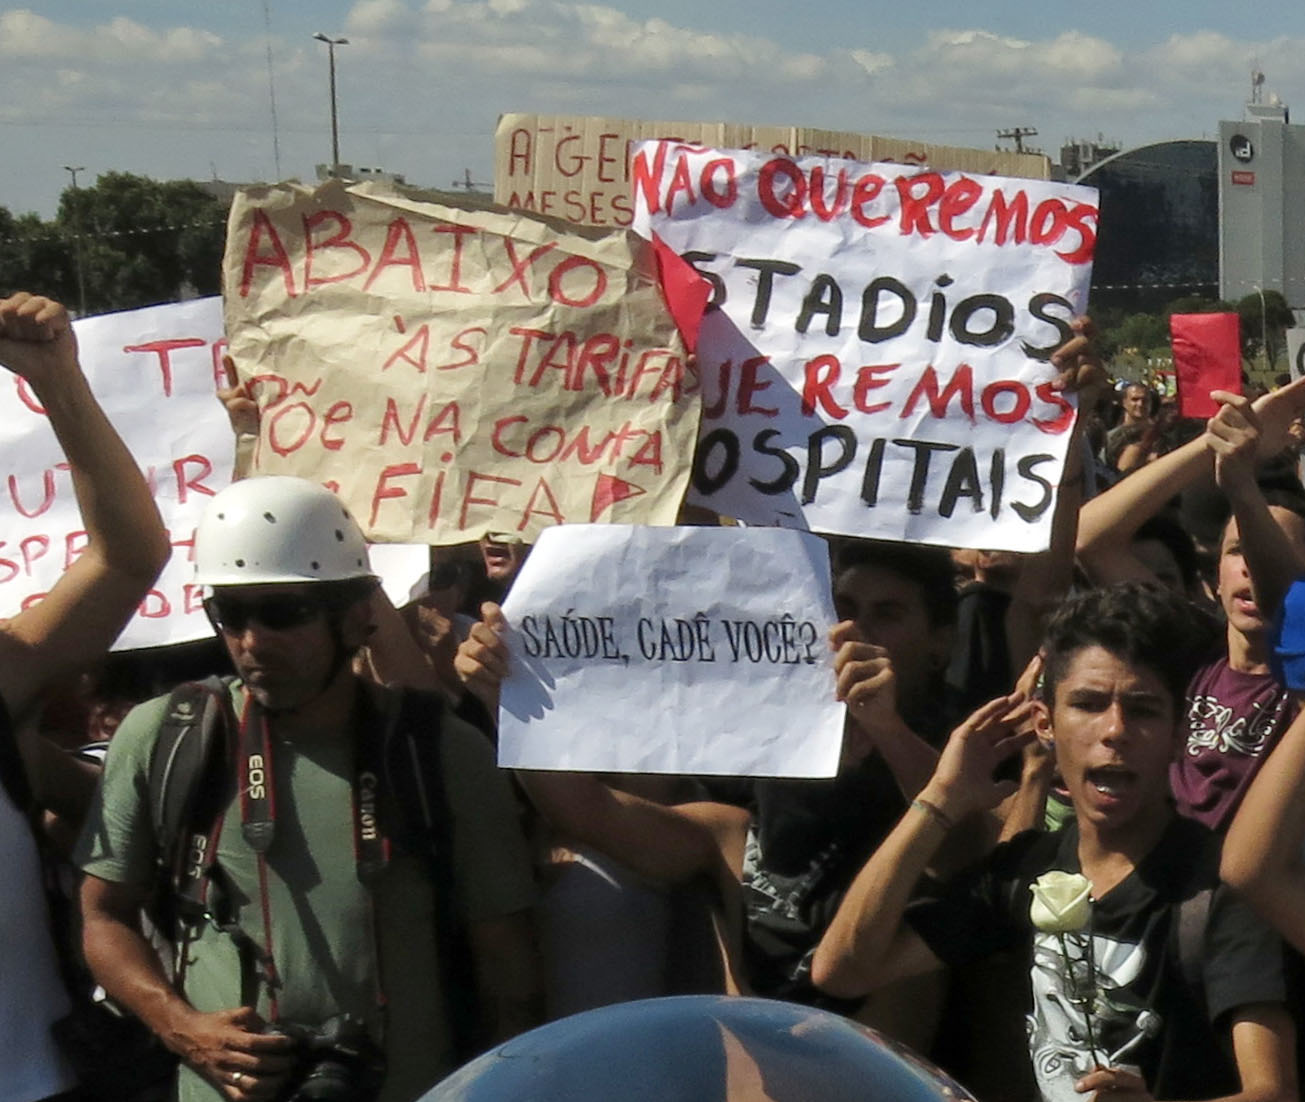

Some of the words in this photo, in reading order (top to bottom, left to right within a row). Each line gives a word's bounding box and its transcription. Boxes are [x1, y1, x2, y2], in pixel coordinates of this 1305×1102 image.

[509, 128, 535, 177] A
[632, 140, 738, 219] NÃO
[239, 206, 609, 309] ABAIXO
[700, 353, 1077, 434] UEREMOS
[378, 396, 463, 450] NA
[490, 414, 665, 477] CONTA
[693, 424, 1056, 524] OSPITAIS
[521, 608, 631, 668] SAÚDE,
[637, 611, 716, 664] CADÊ
[721, 613, 819, 665] VOCÊ?
[248, 754, 265, 801] EOS
